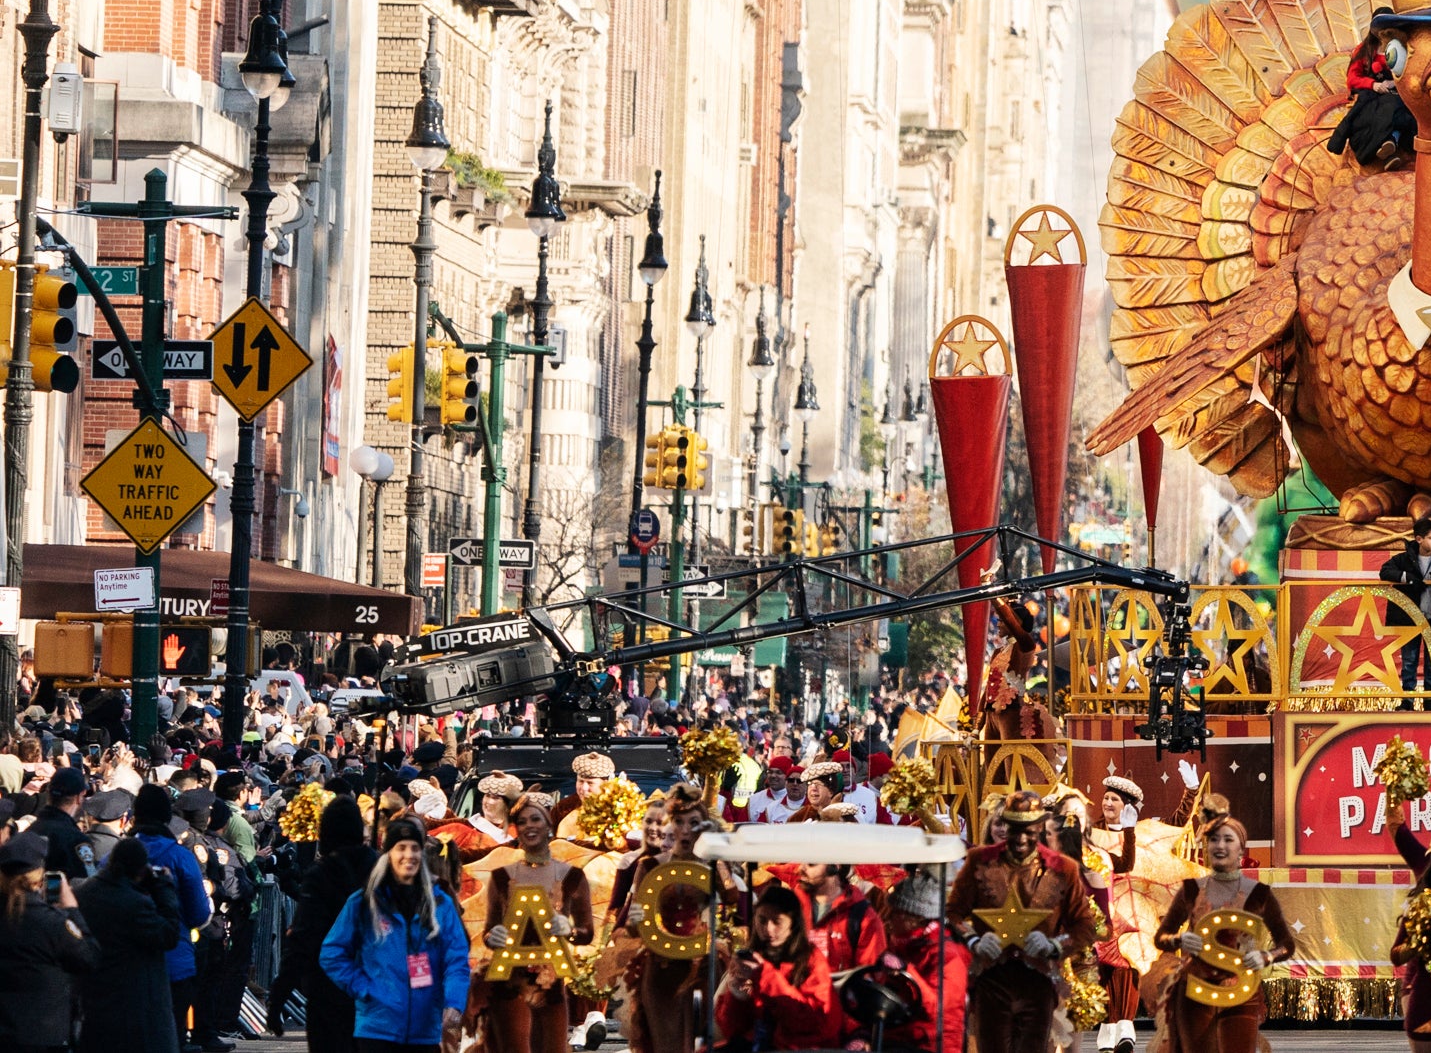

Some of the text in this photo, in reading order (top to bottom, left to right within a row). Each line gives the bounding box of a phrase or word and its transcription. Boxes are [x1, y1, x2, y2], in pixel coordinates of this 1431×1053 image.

[122, 271, 135, 282] ST
[134, 444, 165, 459] TWO
[134, 465, 163, 479] WAY
[118, 484, 179, 500] TRAFFIC
[123, 506, 173, 520] AHEAD
[460, 547, 484, 558] ONE
[99, 572, 140, 582] NO PARKING
[100, 582, 128, 591] Anytime
[355, 605, 379, 624] 25
[1186, 908, 1268, 1008] S
